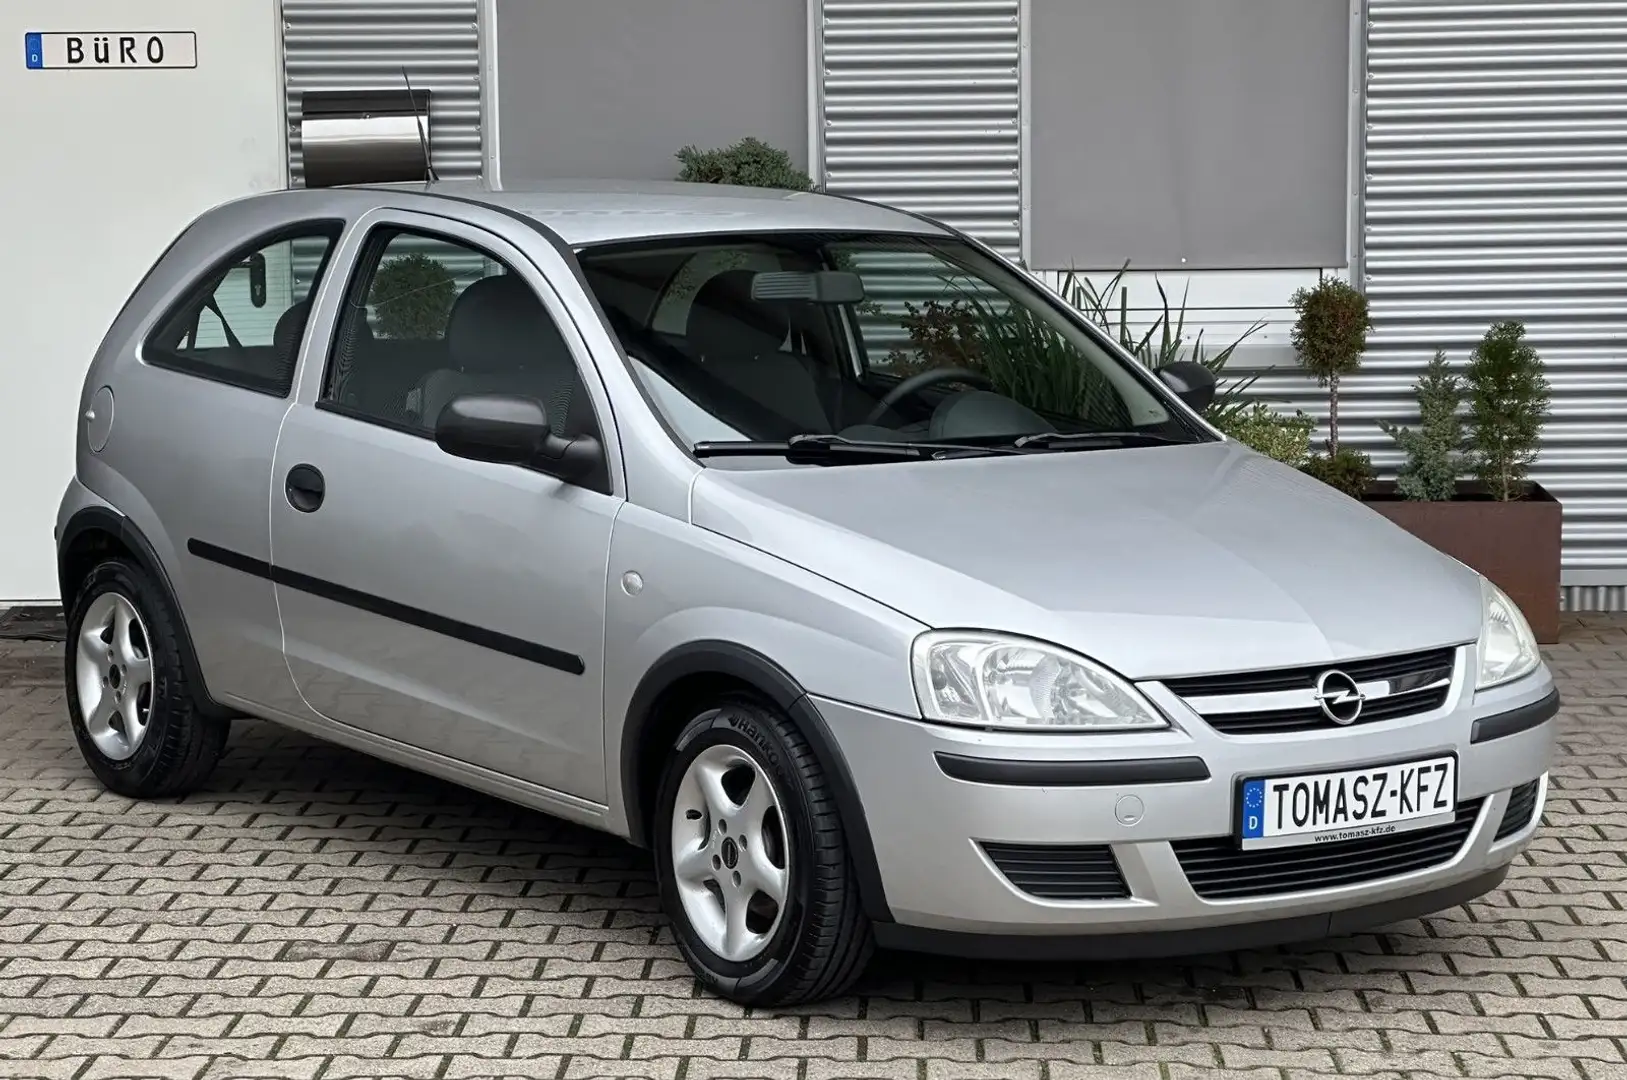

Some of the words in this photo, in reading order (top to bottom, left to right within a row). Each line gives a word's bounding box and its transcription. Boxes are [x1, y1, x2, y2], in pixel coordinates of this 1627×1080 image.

[31, 54, 38, 62] D
[1273, 763, 1448, 829] TOMASZ-KFZ
[1249, 816, 1258, 830] D
[1314, 824, 1396, 842] www.tomasz-kfz.de
